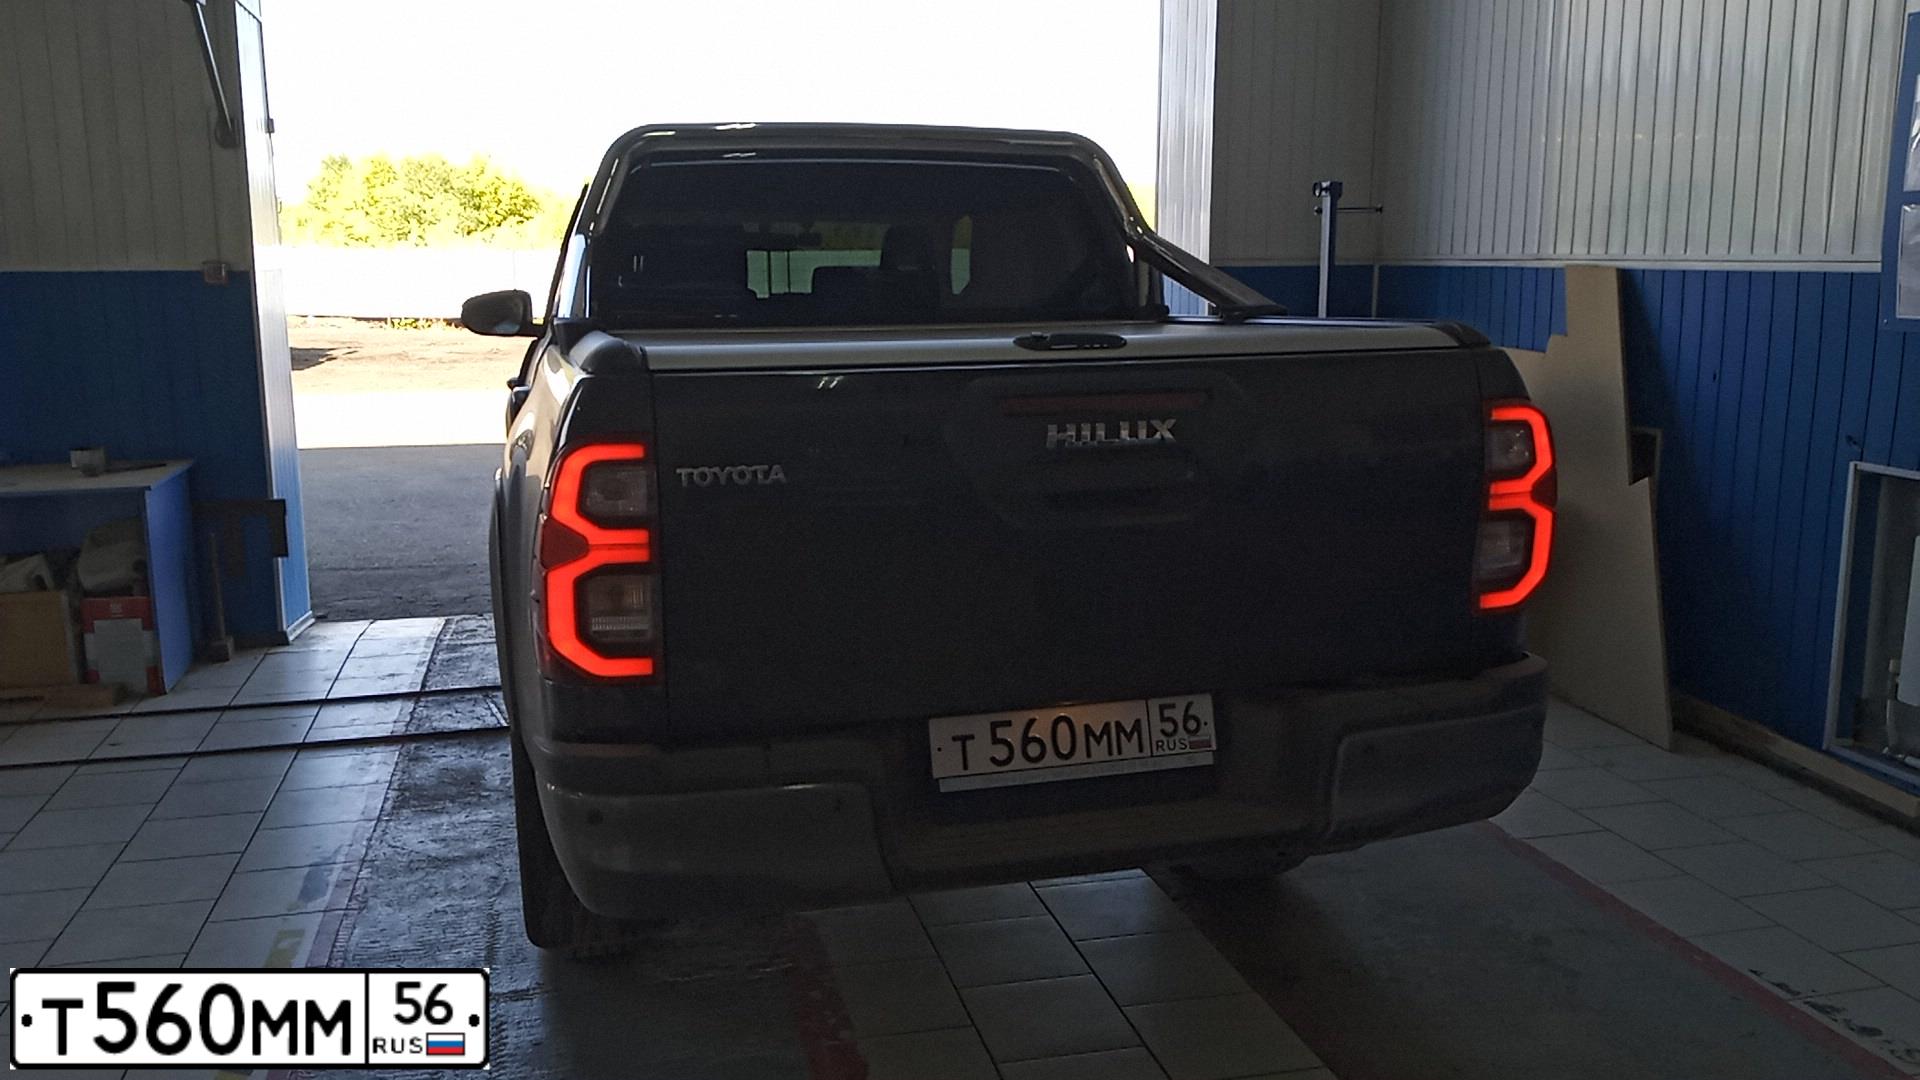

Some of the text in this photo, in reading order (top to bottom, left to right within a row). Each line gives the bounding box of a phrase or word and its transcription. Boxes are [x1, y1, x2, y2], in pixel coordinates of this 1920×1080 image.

[1047, 418, 1177, 448] HILUX
[675, 464, 786, 487] TOYOTA
[1159, 701, 1202, 737] 56
[1155, 738, 1188, 752] RUS
